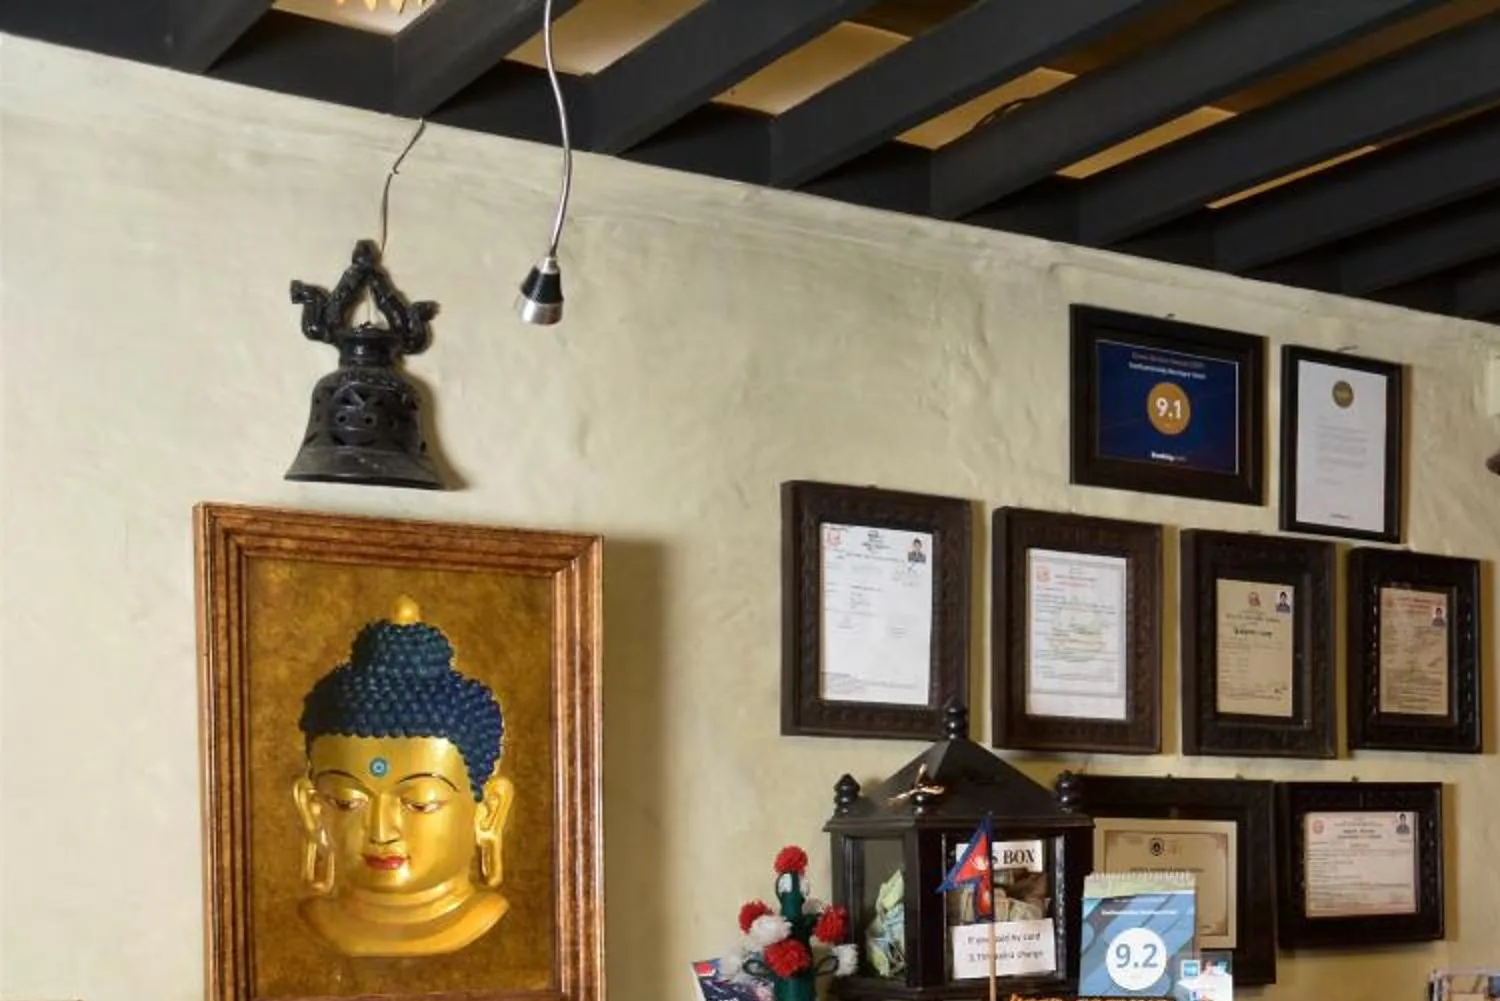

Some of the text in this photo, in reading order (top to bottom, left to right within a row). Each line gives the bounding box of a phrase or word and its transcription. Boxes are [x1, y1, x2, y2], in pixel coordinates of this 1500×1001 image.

[1155, 397, 1182, 420] 9.1
[1003, 848, 1035, 864] BOX
[1116, 943, 1158, 968] 9.2
